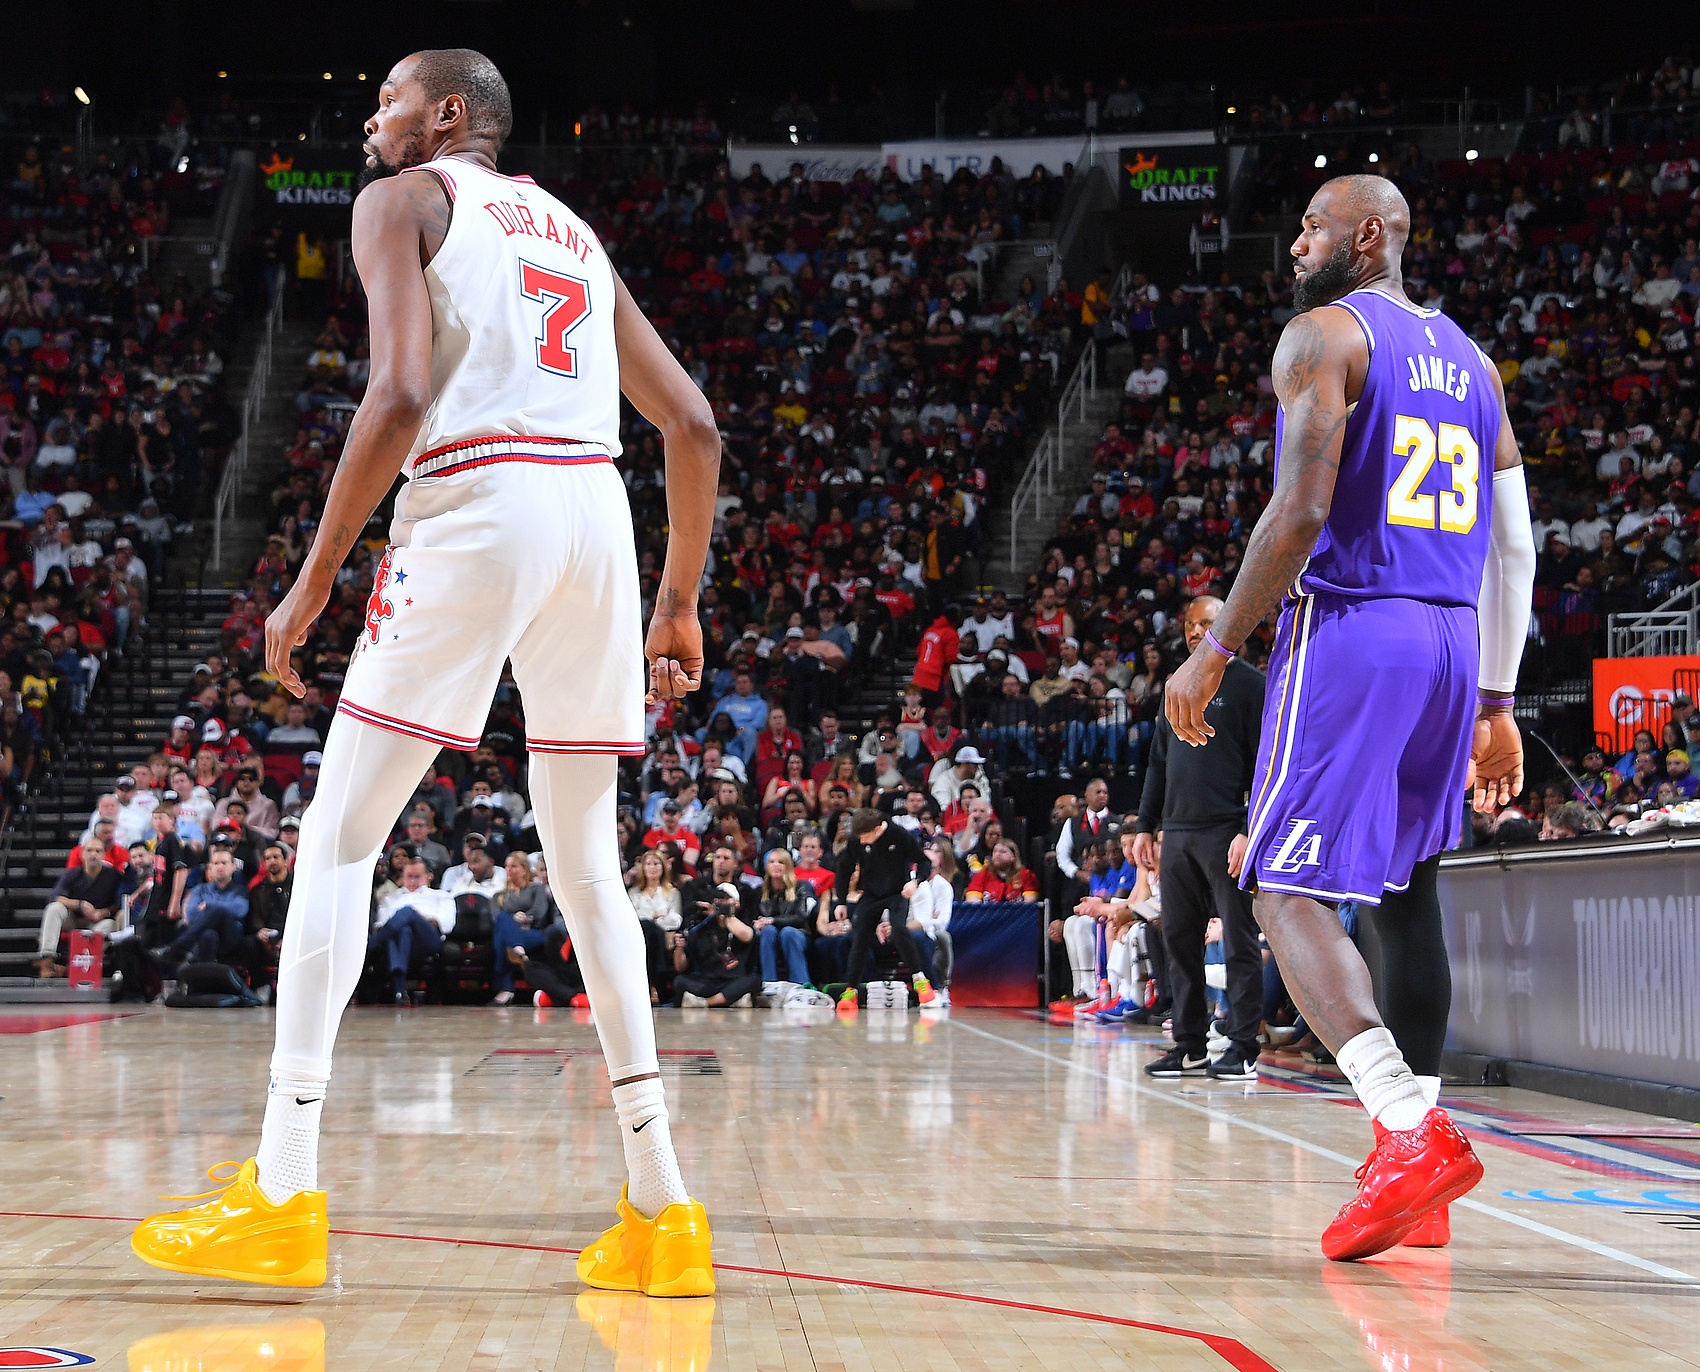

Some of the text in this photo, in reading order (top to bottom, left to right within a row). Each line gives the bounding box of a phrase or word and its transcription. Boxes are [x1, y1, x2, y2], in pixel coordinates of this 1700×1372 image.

[265, 169, 356, 191] DRAFT
[277, 187, 353, 204] KINGS
[1130, 166, 1218, 189] DRAFT
[1140, 184, 1216, 202] KINGS
[483, 200, 593, 264] DURANT
[518, 256, 592, 380] 7
[1406, 353, 1470, 402] JAMES
[1387, 414, 1479, 535] 23
[1263, 818, 1323, 874] LA
